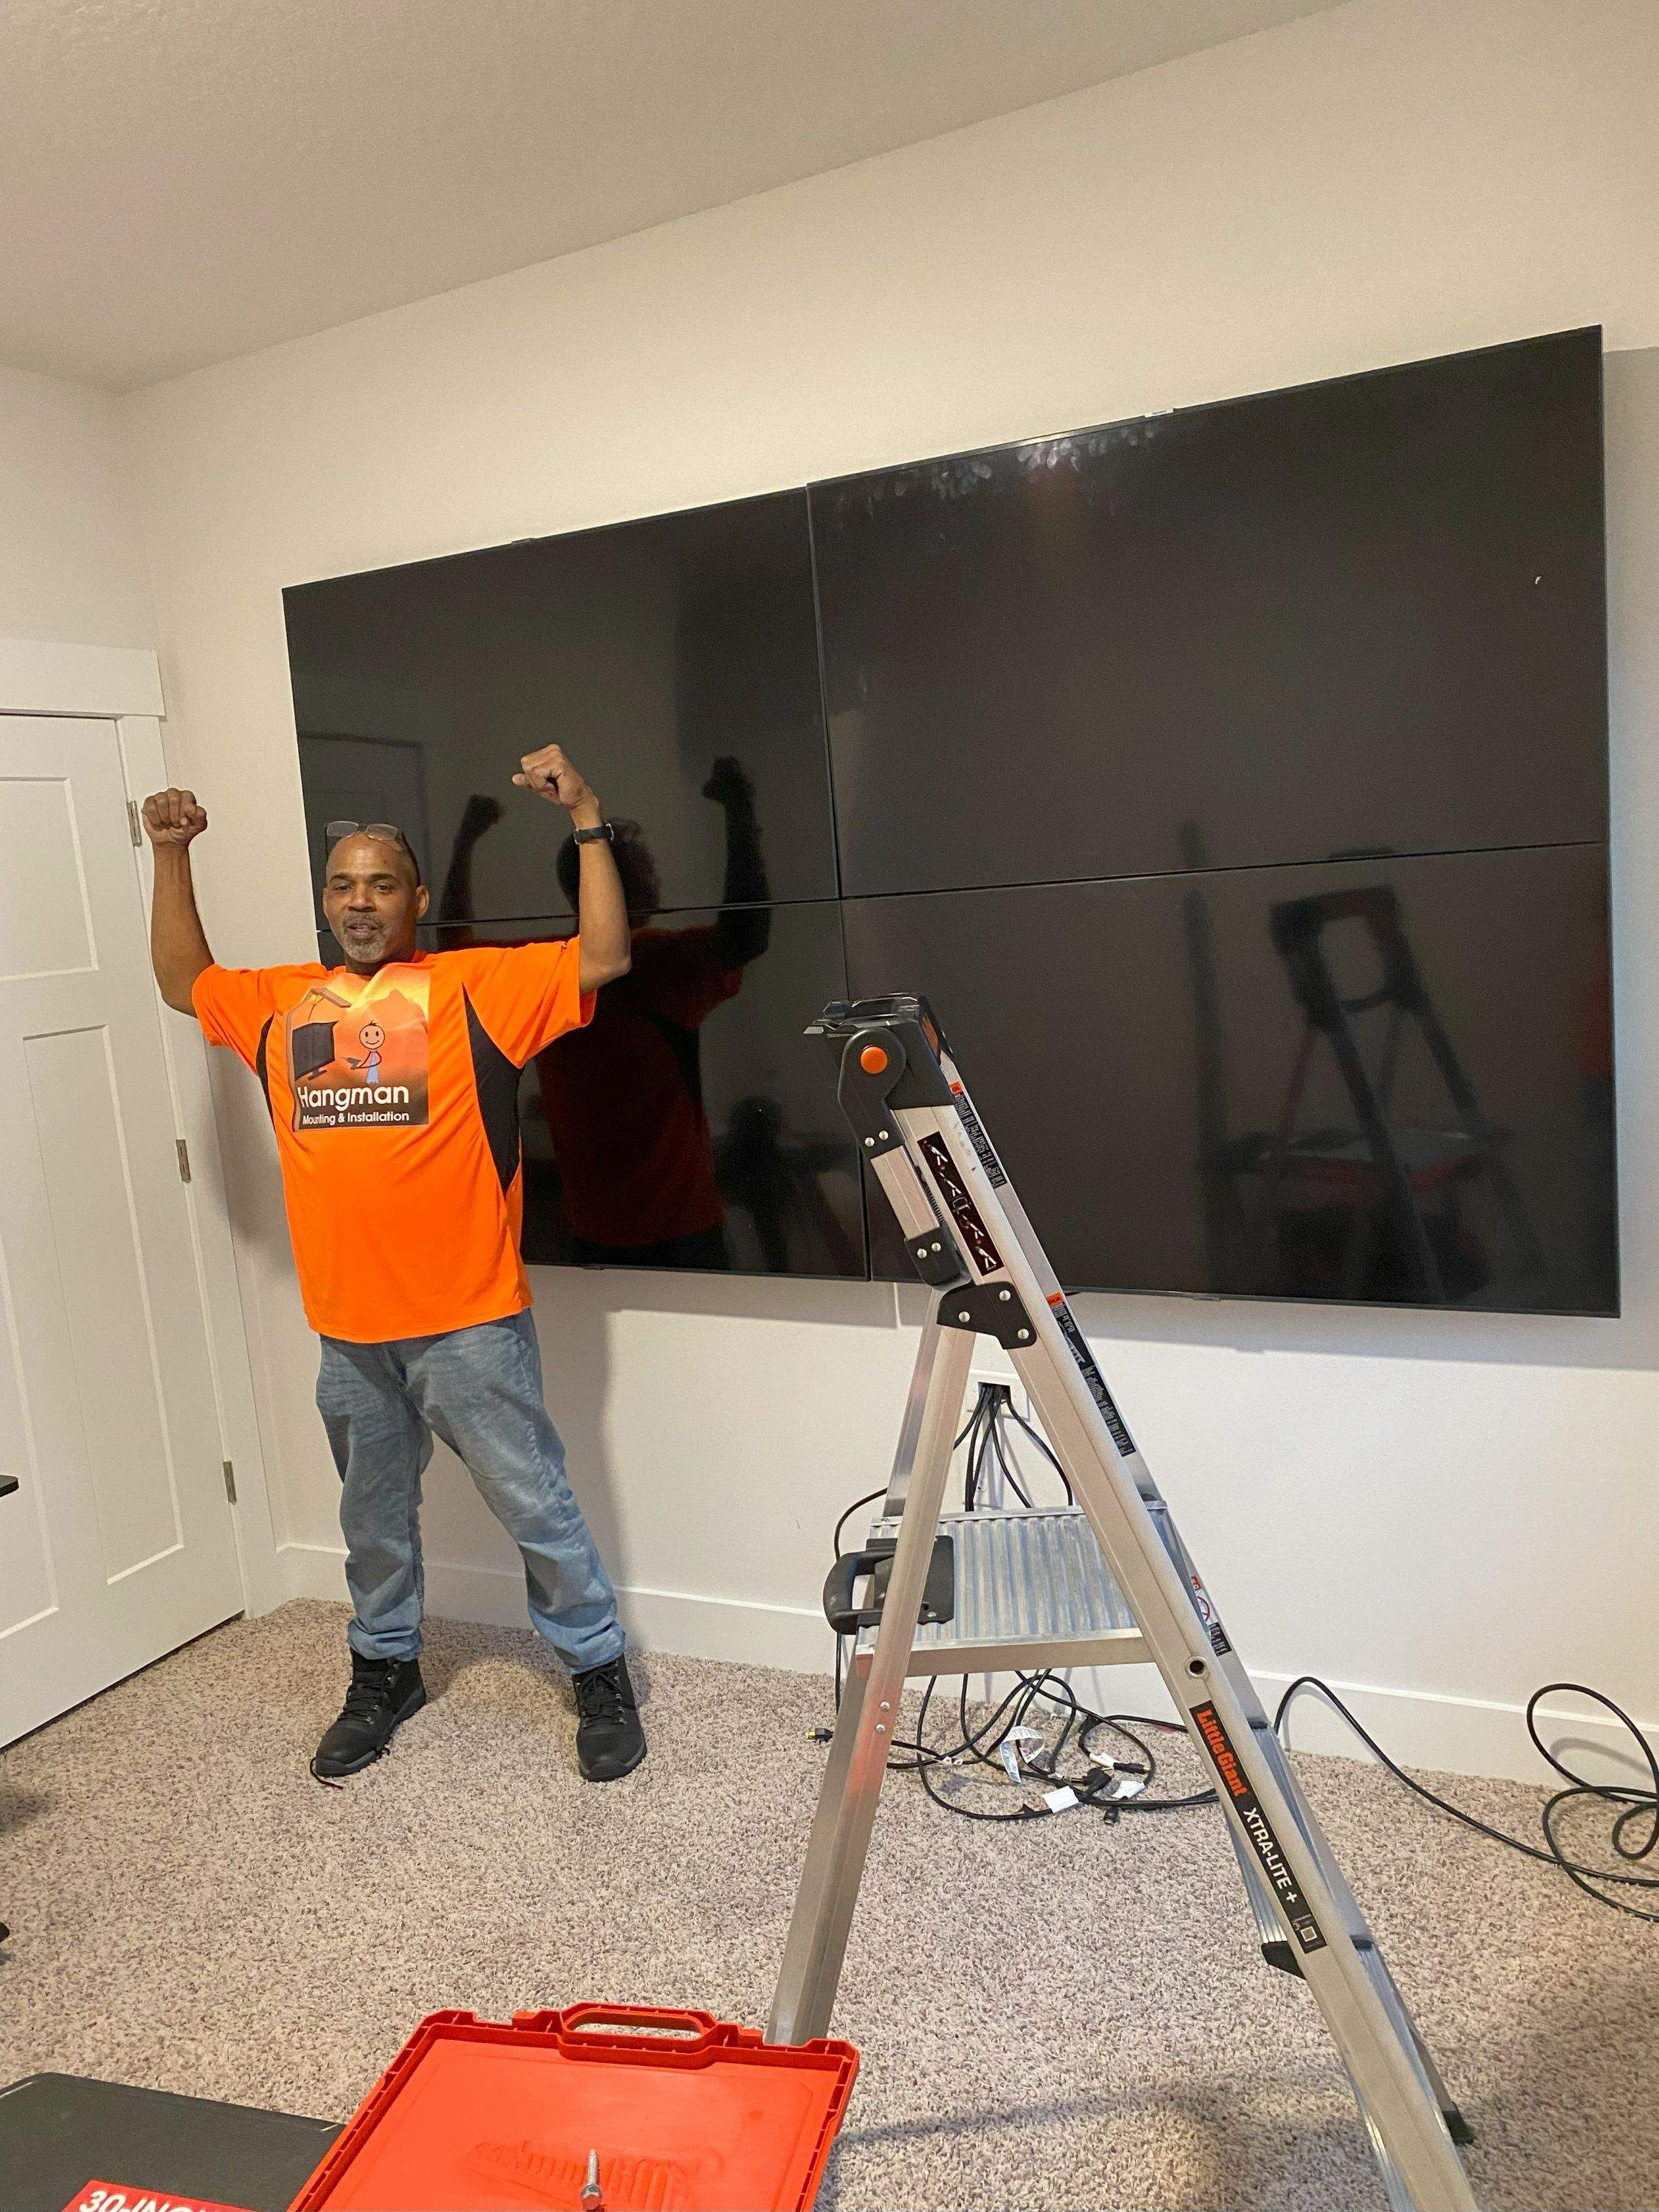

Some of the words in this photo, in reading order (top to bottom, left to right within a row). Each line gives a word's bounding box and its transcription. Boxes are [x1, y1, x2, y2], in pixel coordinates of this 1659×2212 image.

[297, 1086, 409, 1111] Hangman
[338, 1112, 346, 1123] &
[347, 1111, 409, 1123] Installation
[1243, 1806, 1293, 1889] XTRA-LITE
